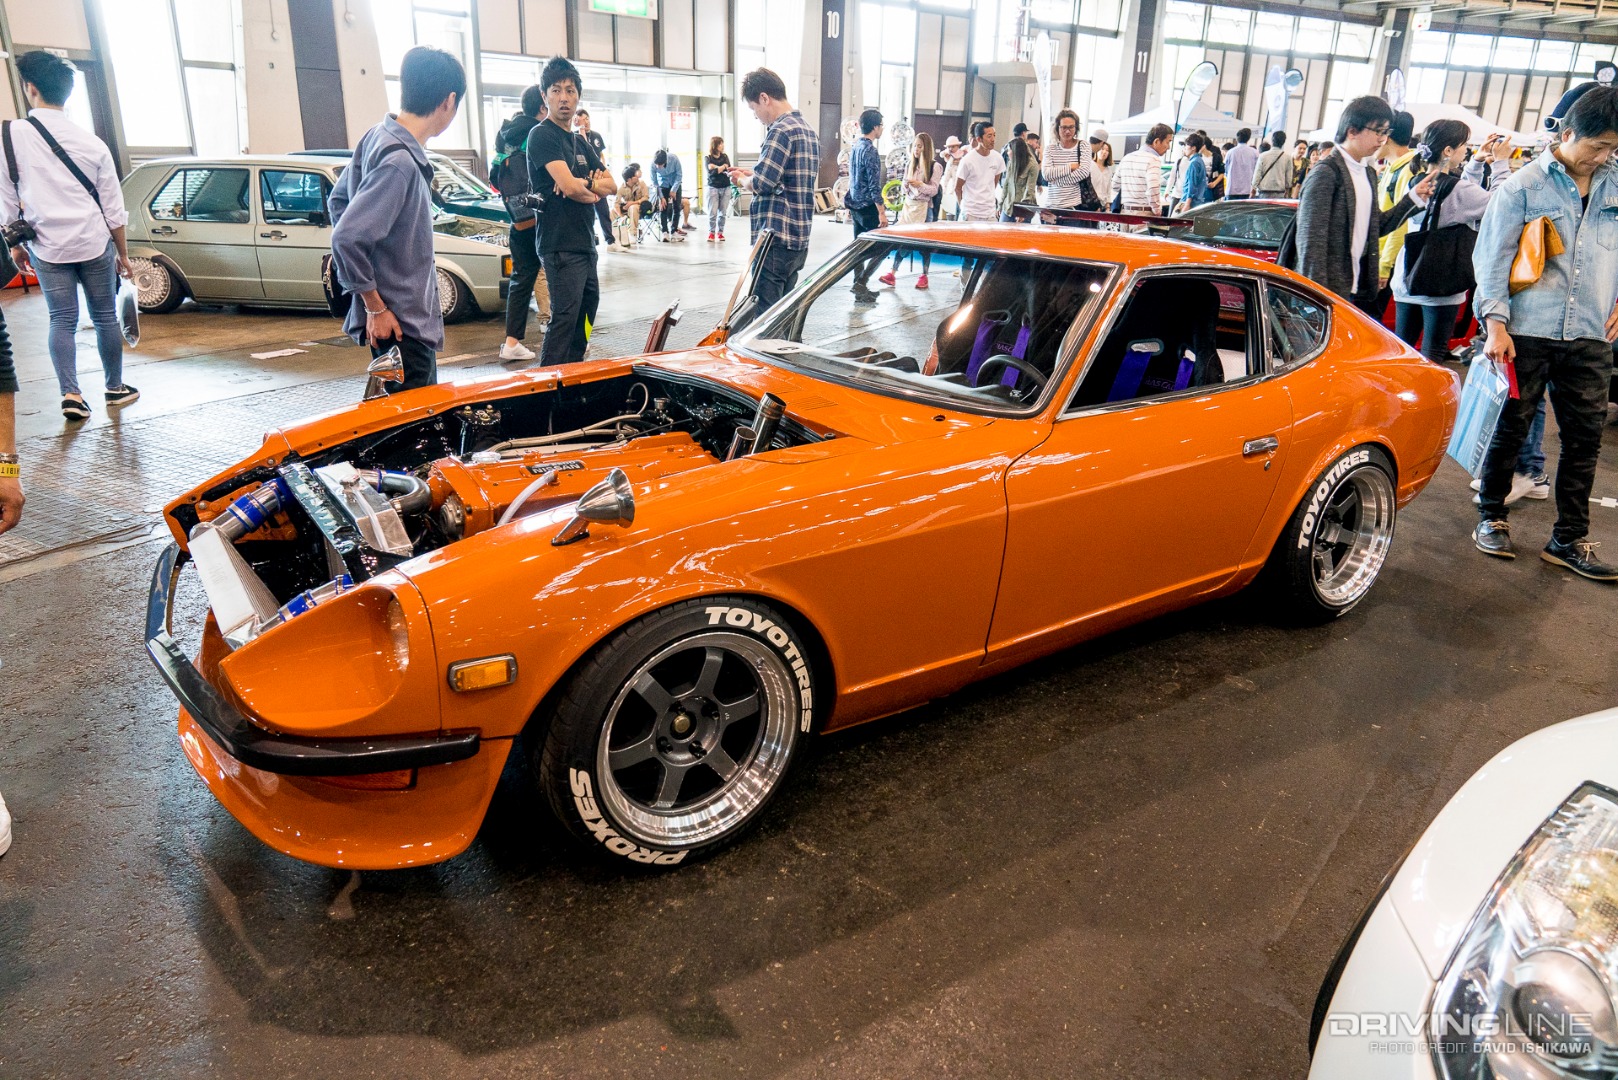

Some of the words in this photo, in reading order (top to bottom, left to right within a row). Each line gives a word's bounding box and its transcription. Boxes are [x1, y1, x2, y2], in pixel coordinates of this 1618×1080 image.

[827, 11, 840, 38] 10
[1137, 51, 1148, 73] 11
[532, 463, 581, 474] NISSAN
[569, 767, 690, 865] PROXES
